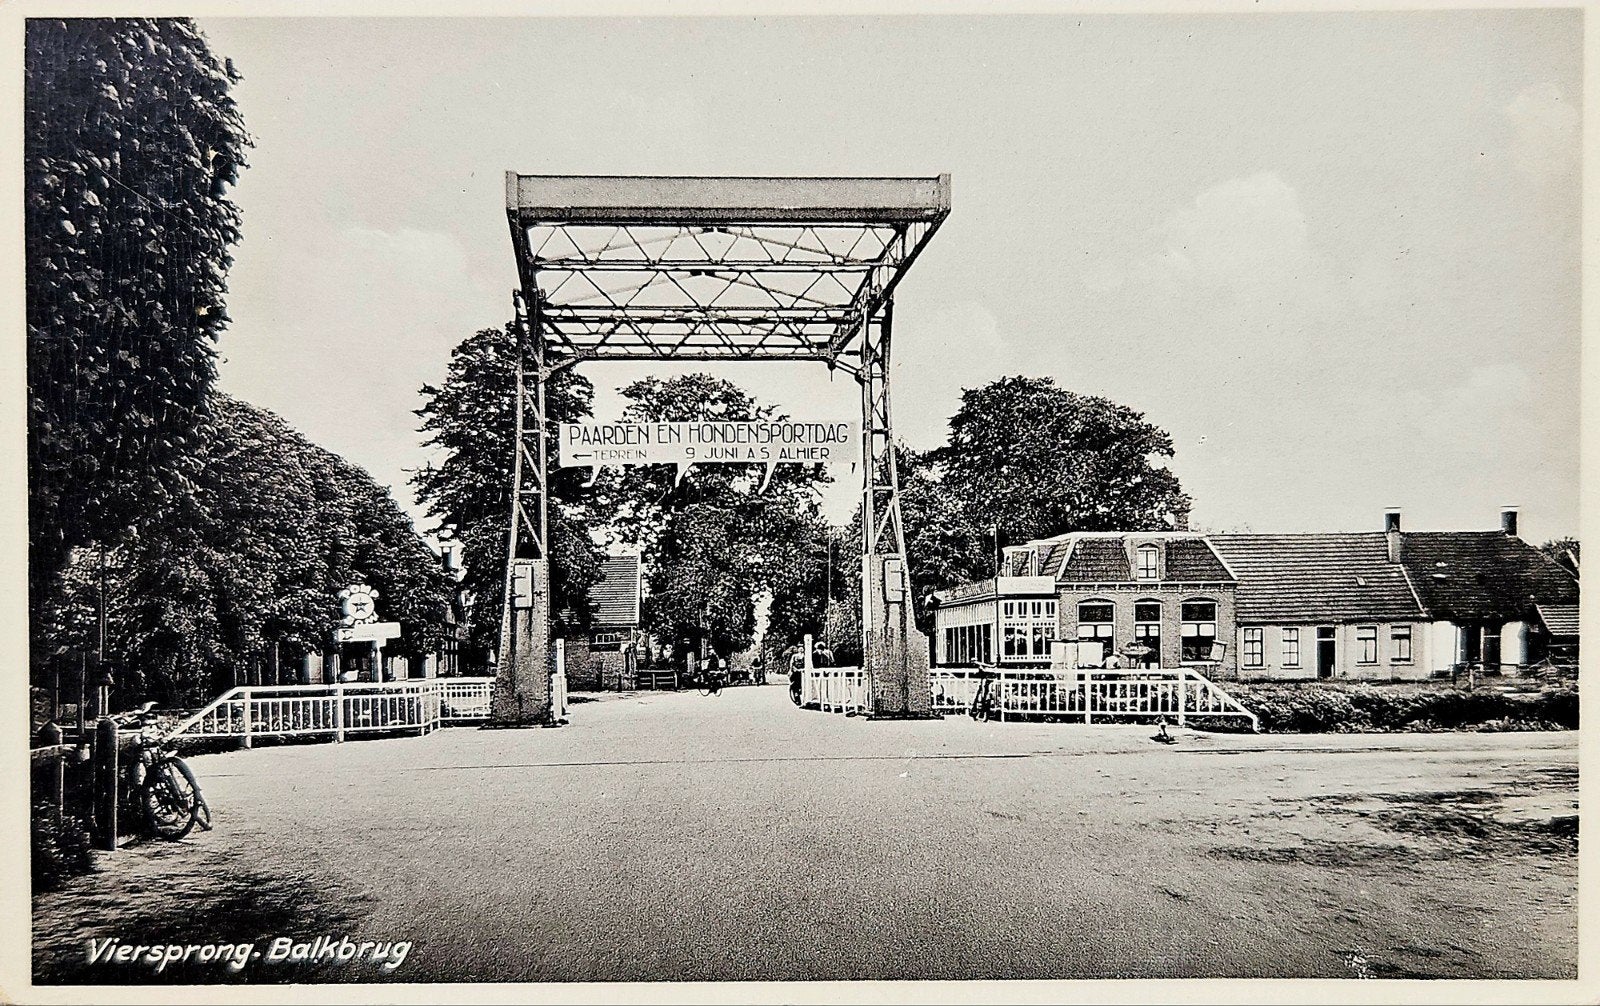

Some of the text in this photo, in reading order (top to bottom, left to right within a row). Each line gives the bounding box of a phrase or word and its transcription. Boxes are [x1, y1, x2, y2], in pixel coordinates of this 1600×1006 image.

[569, 423, 848, 445] PAARDEN EN HONDENSPORTDAG
[593, 449, 648, 460] TERREIN
[685, 447, 696, 459] 9
[704, 447, 738, 459] JUNI
[779, 447, 830, 460] ALHIER
